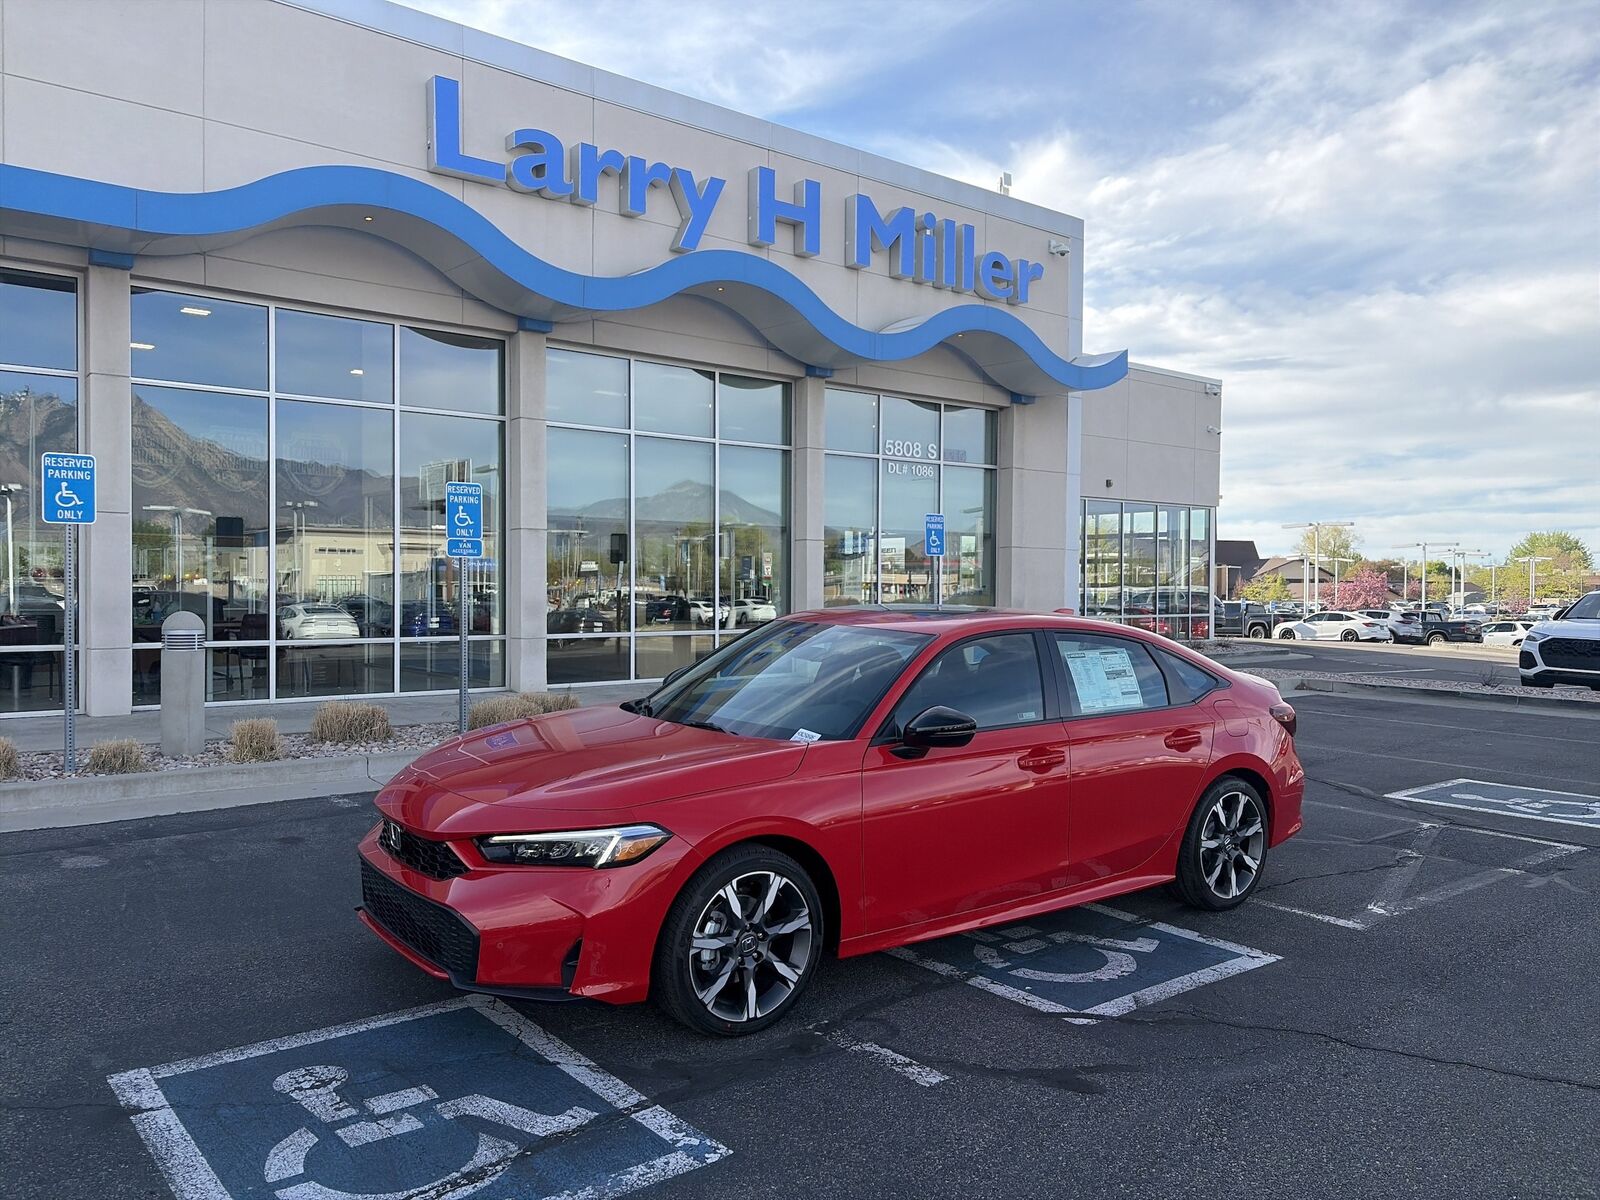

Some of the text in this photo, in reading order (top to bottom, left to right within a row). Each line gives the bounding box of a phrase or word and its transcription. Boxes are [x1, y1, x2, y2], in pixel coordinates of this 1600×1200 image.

[427, 75, 1044, 305] Larry H Miller
[885, 440, 937, 459] 5808 S
[44, 457, 94, 468] RESERVED
[48, 469, 91, 480] PARKING
[887, 462, 934, 477] DL# 1086
[447, 486, 480, 494] RESERVED
[449, 495, 479, 504] PARKING
[57, 510, 83, 519] ONLY
[456, 529, 474, 537] ONLY
